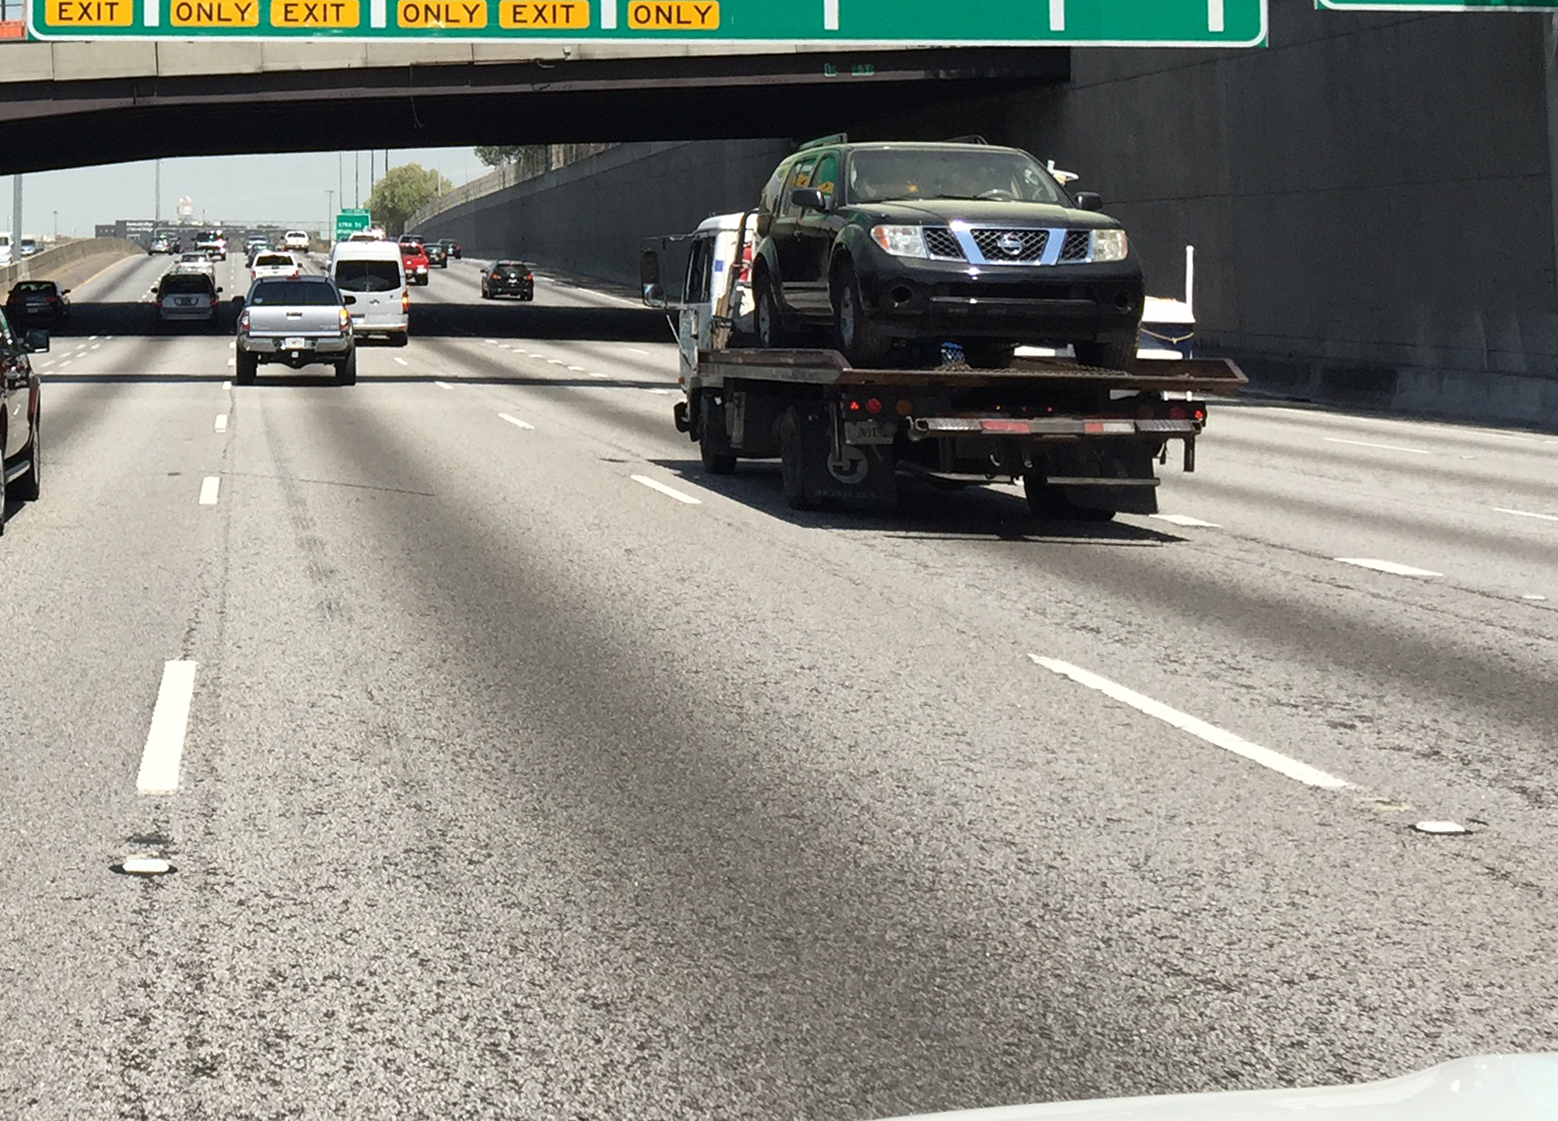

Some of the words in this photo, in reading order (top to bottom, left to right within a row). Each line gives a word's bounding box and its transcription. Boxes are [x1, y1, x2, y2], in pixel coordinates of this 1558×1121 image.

[58, 1, 120, 21] EXIT
[176, 1, 252, 22] ONLY
[284, 2, 346, 23] EXIT
[402, 3, 481, 24] ONLY
[512, 4, 575, 24] EXIT
[634, 4, 712, 25] ONLY
